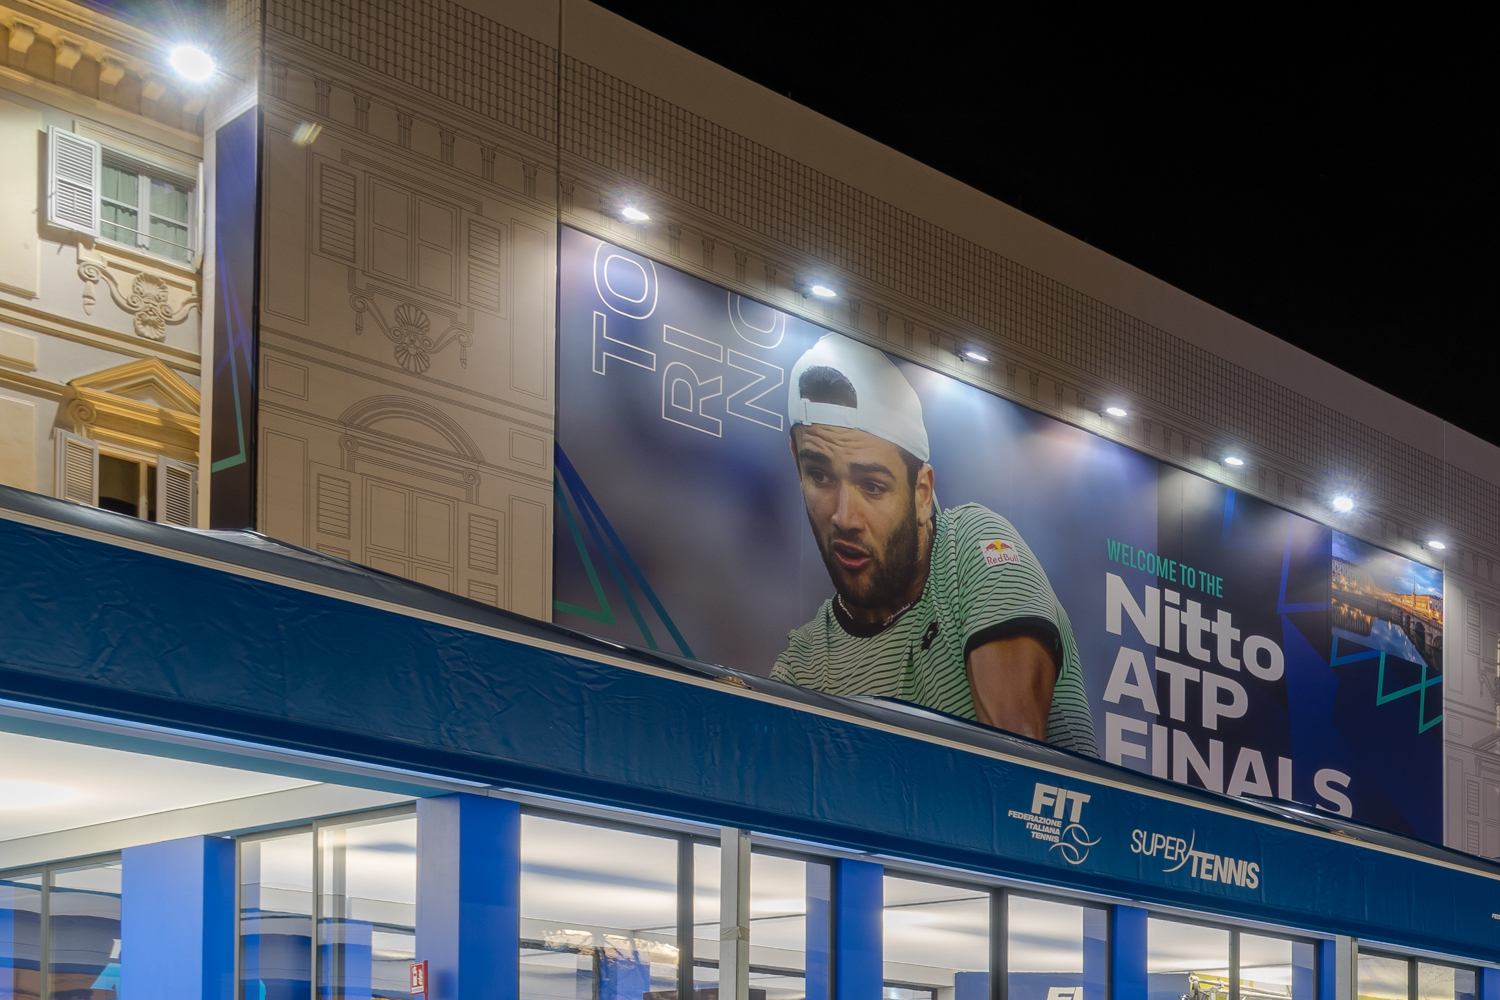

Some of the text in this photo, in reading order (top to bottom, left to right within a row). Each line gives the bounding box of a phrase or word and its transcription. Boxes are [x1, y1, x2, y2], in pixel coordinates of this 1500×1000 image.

[592, 241, 659, 376] TO
[986, 553, 1020, 565] Red Bull
[1106, 538, 1224, 598] WELCOME TO THE
[1105, 571, 1285, 682] Nitto
[1102, 646, 1249, 731] ATP
[1105, 711, 1353, 818] FINALS
[1007, 809, 1063, 828] FEDERAZIONE
[1030, 782, 1092, 823] FIT
[1026, 821, 1061, 836] ITALIANA
[1031, 830, 1060, 843] TENNIS
[1187, 850, 1260, 890] TENNIS
